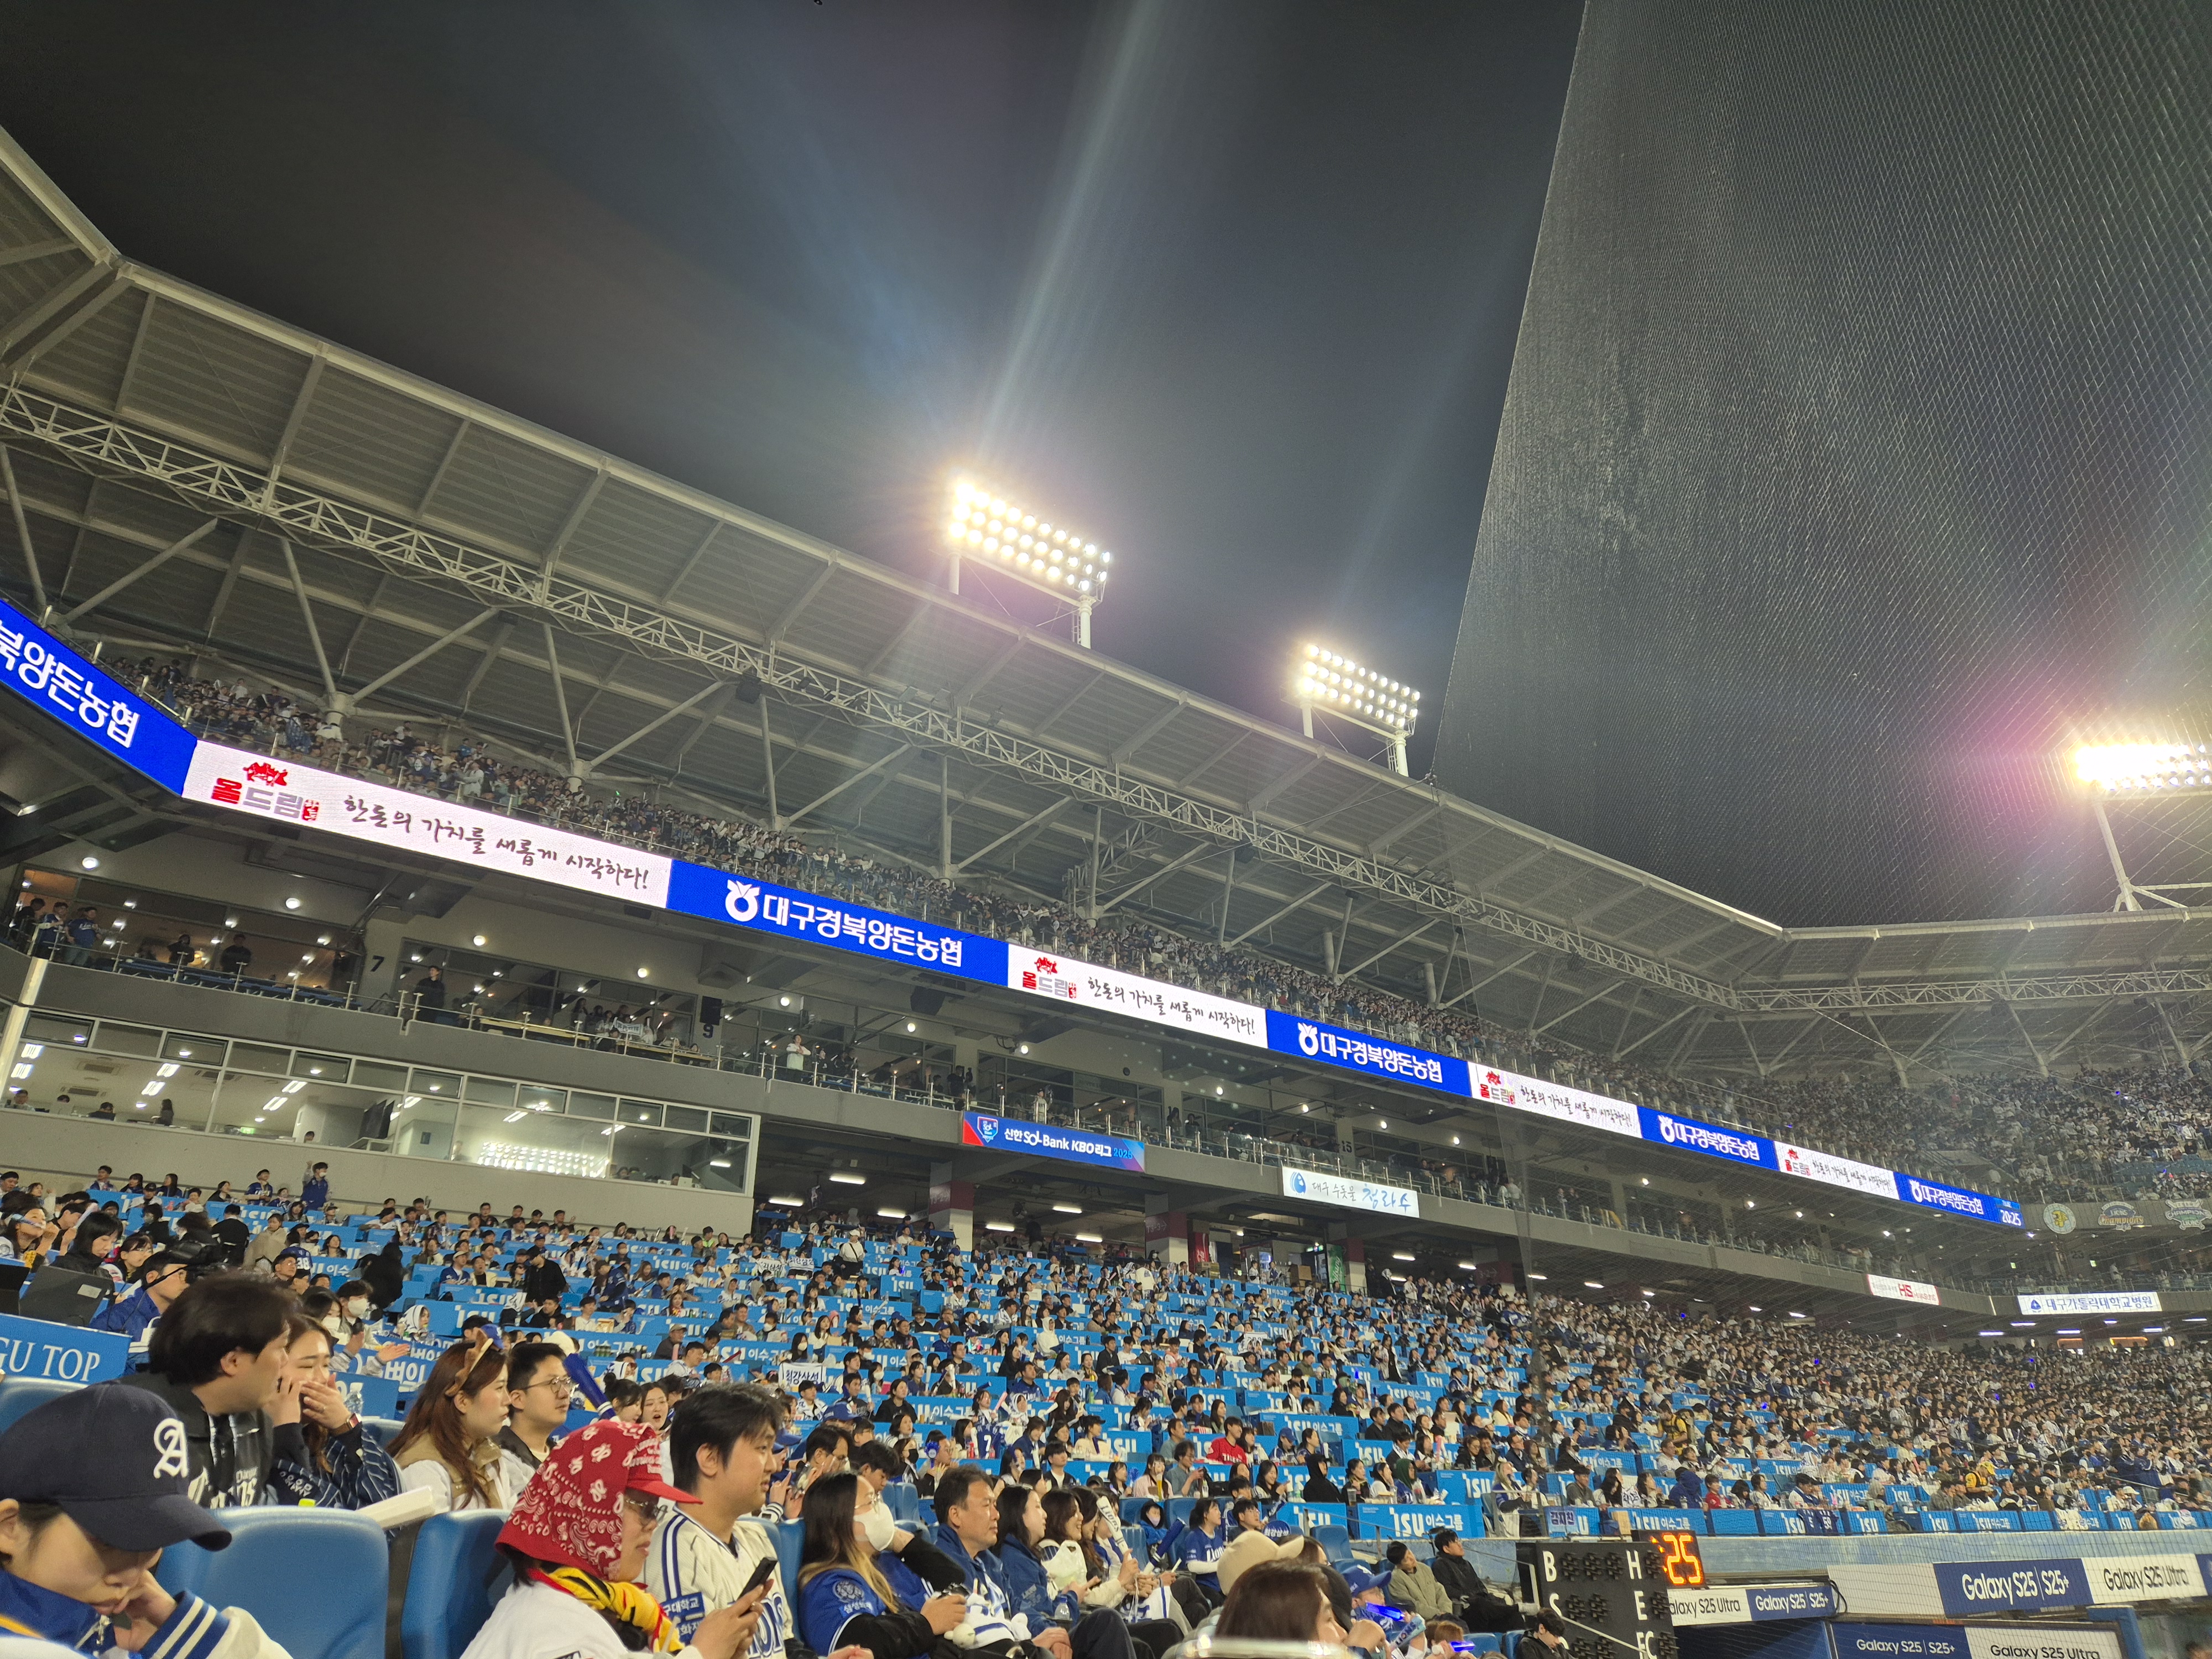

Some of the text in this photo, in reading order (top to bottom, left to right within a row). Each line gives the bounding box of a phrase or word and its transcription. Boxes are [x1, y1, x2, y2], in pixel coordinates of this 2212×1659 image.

[0, 620, 140, 748] 북양돈농협
[211, 778, 304, 818] 올드림
[421, 818, 487, 854] 가치를
[495, 838, 557, 865] 새롭게
[566, 854, 649, 889] 시작하다!
[763, 894, 962, 968] 대구경북양돈농협
[371, 956, 384, 972] 7
[1022, 971, 1068, 998] 올드림
[1129, 990, 1166, 1016] 가치를
[1170, 1003, 1204, 1022] 새롭게
[1208, 1011, 1255, 1035] 시작하다!
[702, 1023, 713, 1039] 9
[1321, 1032, 1443, 1083] 대구경북양돈농협
[1548, 1094, 1574, 1115] 가치를
[1574, 1102, 1598, 1119] 새롭게
[1599, 1107, 1632, 1127] 시작하다!
[1004, 1128, 1023, 1142] 신한
[1042, 1134, 1070, 1150] Bank
[1113, 1147, 1133, 1160] 2025
[1674, 1122, 1760, 1161] 대구경북양돈농협
[1311, 1182, 1412, 1214] 대구 수돗물 청라수
[1922, 1185, 1984, 1215] 대구경북양돈농협
[2000, 1209, 2022, 1226] 20:25
[296, 1257, 310, 1270] 38
[1898, 1283, 1914, 1298] HS
[2046, 1296, 2153, 1310] 대구가톨릭대학교병원
[41, 1344, 101, 1382] TOP
[984, 1434, 992, 1452] 7
[1389, 1507, 1463, 1537] ISU 이수그룹
[1543, 1550, 1643, 1582] B H
[1662, 1533, 1702, 1585] 25
[1962, 1569, 2069, 1605] Galaxy S25 S25+
[2103, 1566, 2189, 1595] Galaxy S25 Ultra
[663, 1598, 699, 1616] 구대학교
[1634, 1591, 1648, 1621] E
[1670, 1597, 1741, 1619] alaxy S25 Ultra
[1755, 1592, 1829, 1614] Galaxy S25 S25+
[1856, 1639, 1955, 1655] Galaxy S25 S25+
[1990, 1644, 2100, 1659] Galaxy S25 Ultra
